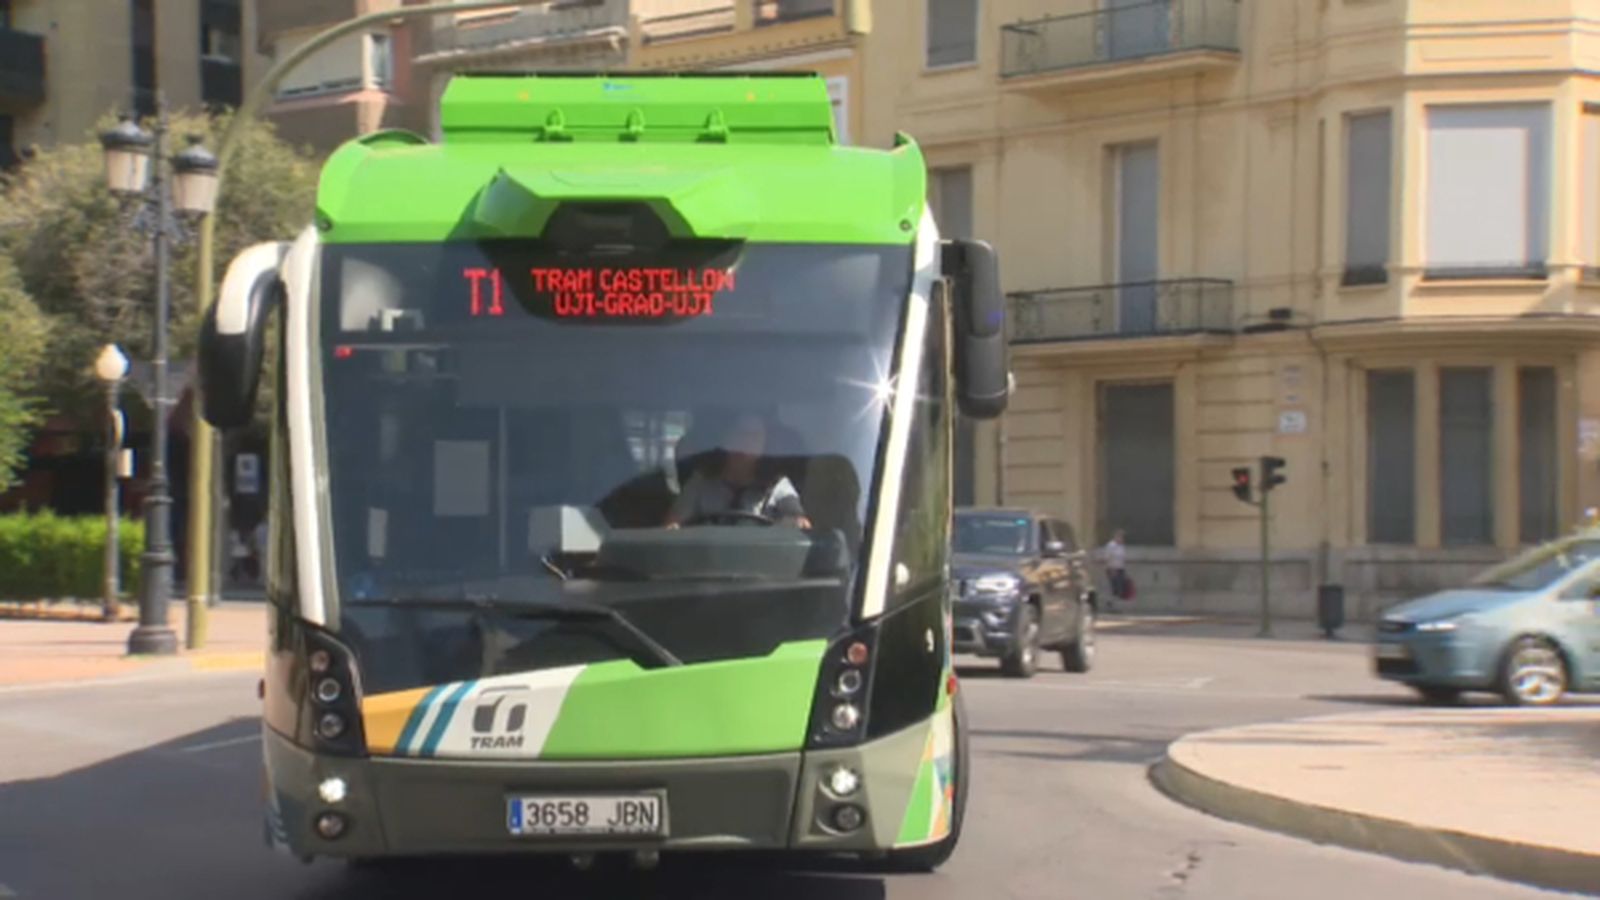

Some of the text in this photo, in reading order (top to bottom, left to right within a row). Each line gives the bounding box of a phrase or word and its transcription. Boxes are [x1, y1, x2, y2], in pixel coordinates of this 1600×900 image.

[463, 268, 504, 315] T1
[532, 269, 735, 291] TRAM CASTELLON
[470, 735, 524, 749] TRAM
[526, 802, 655, 826] 3658 JBN
